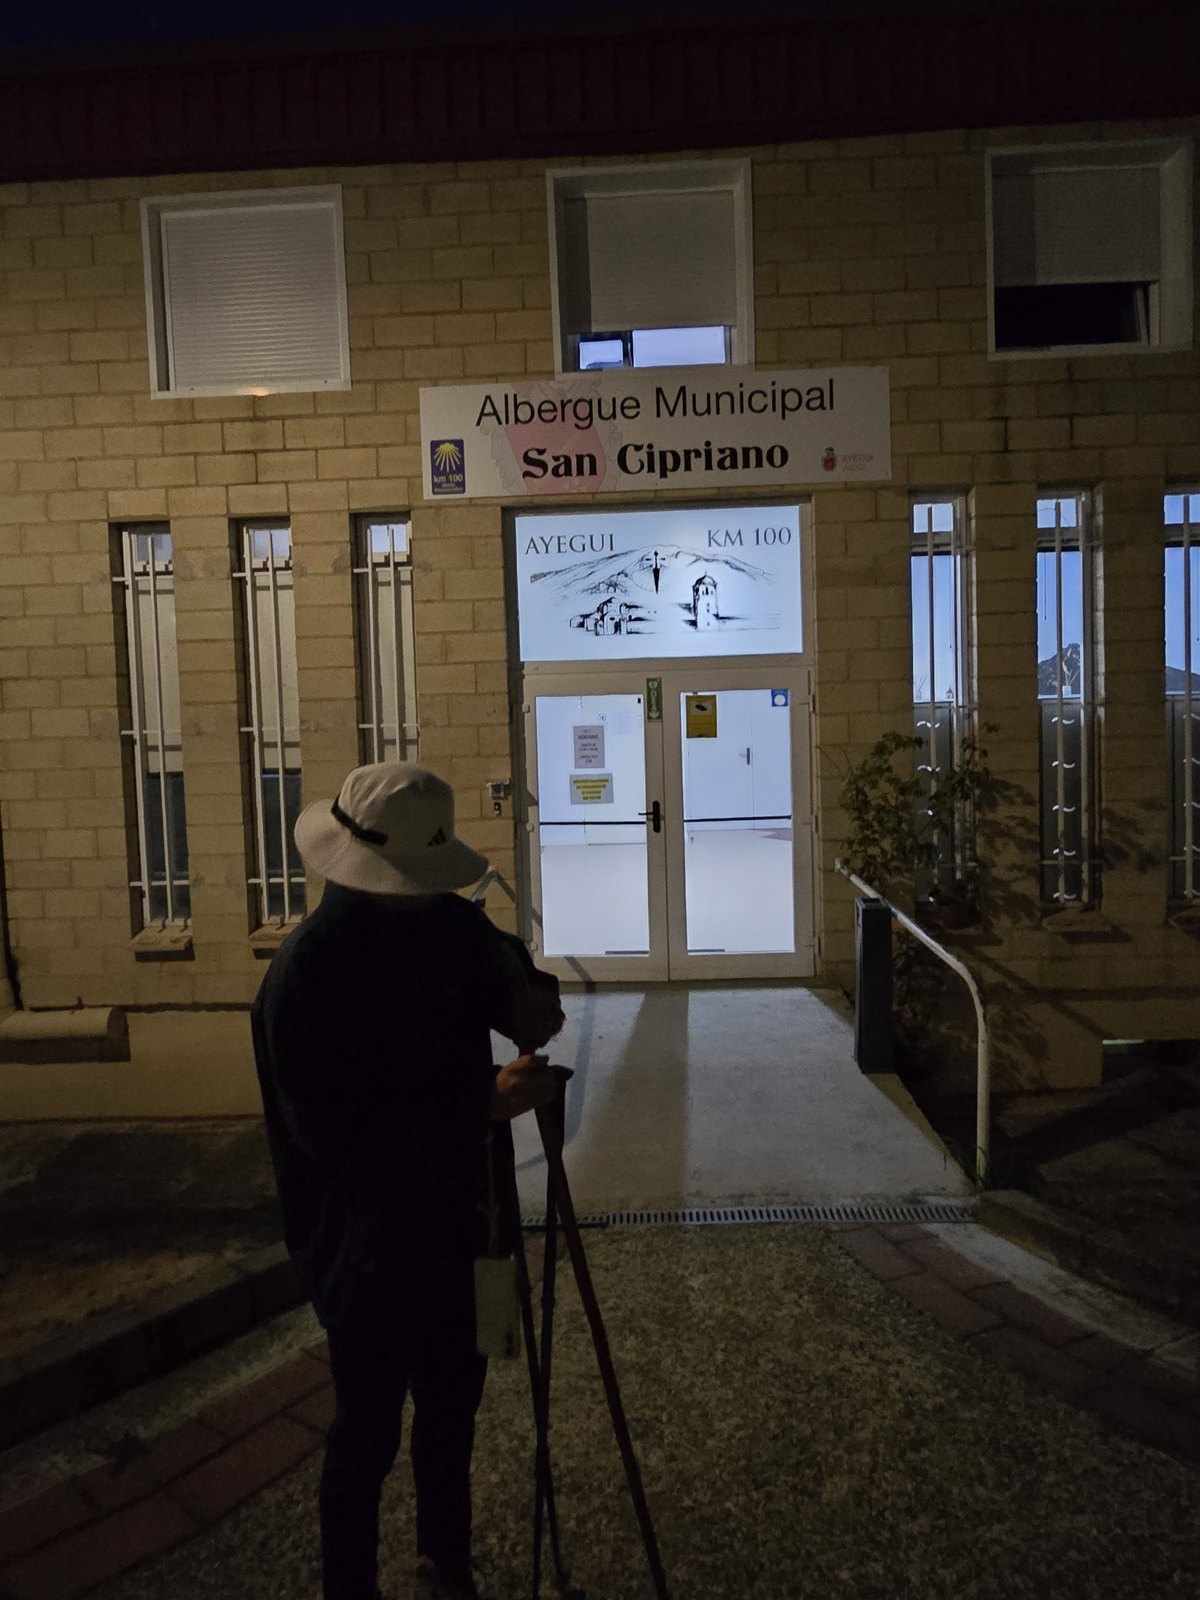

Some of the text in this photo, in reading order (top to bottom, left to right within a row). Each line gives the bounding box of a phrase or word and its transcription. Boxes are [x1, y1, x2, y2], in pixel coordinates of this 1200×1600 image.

[475, 378, 835, 431] Albergue Municipal
[522, 440, 789, 479] San Cipriano
[433, 474, 463, 483] km 100
[524, 526, 792, 555] AYEGUI KM 100
